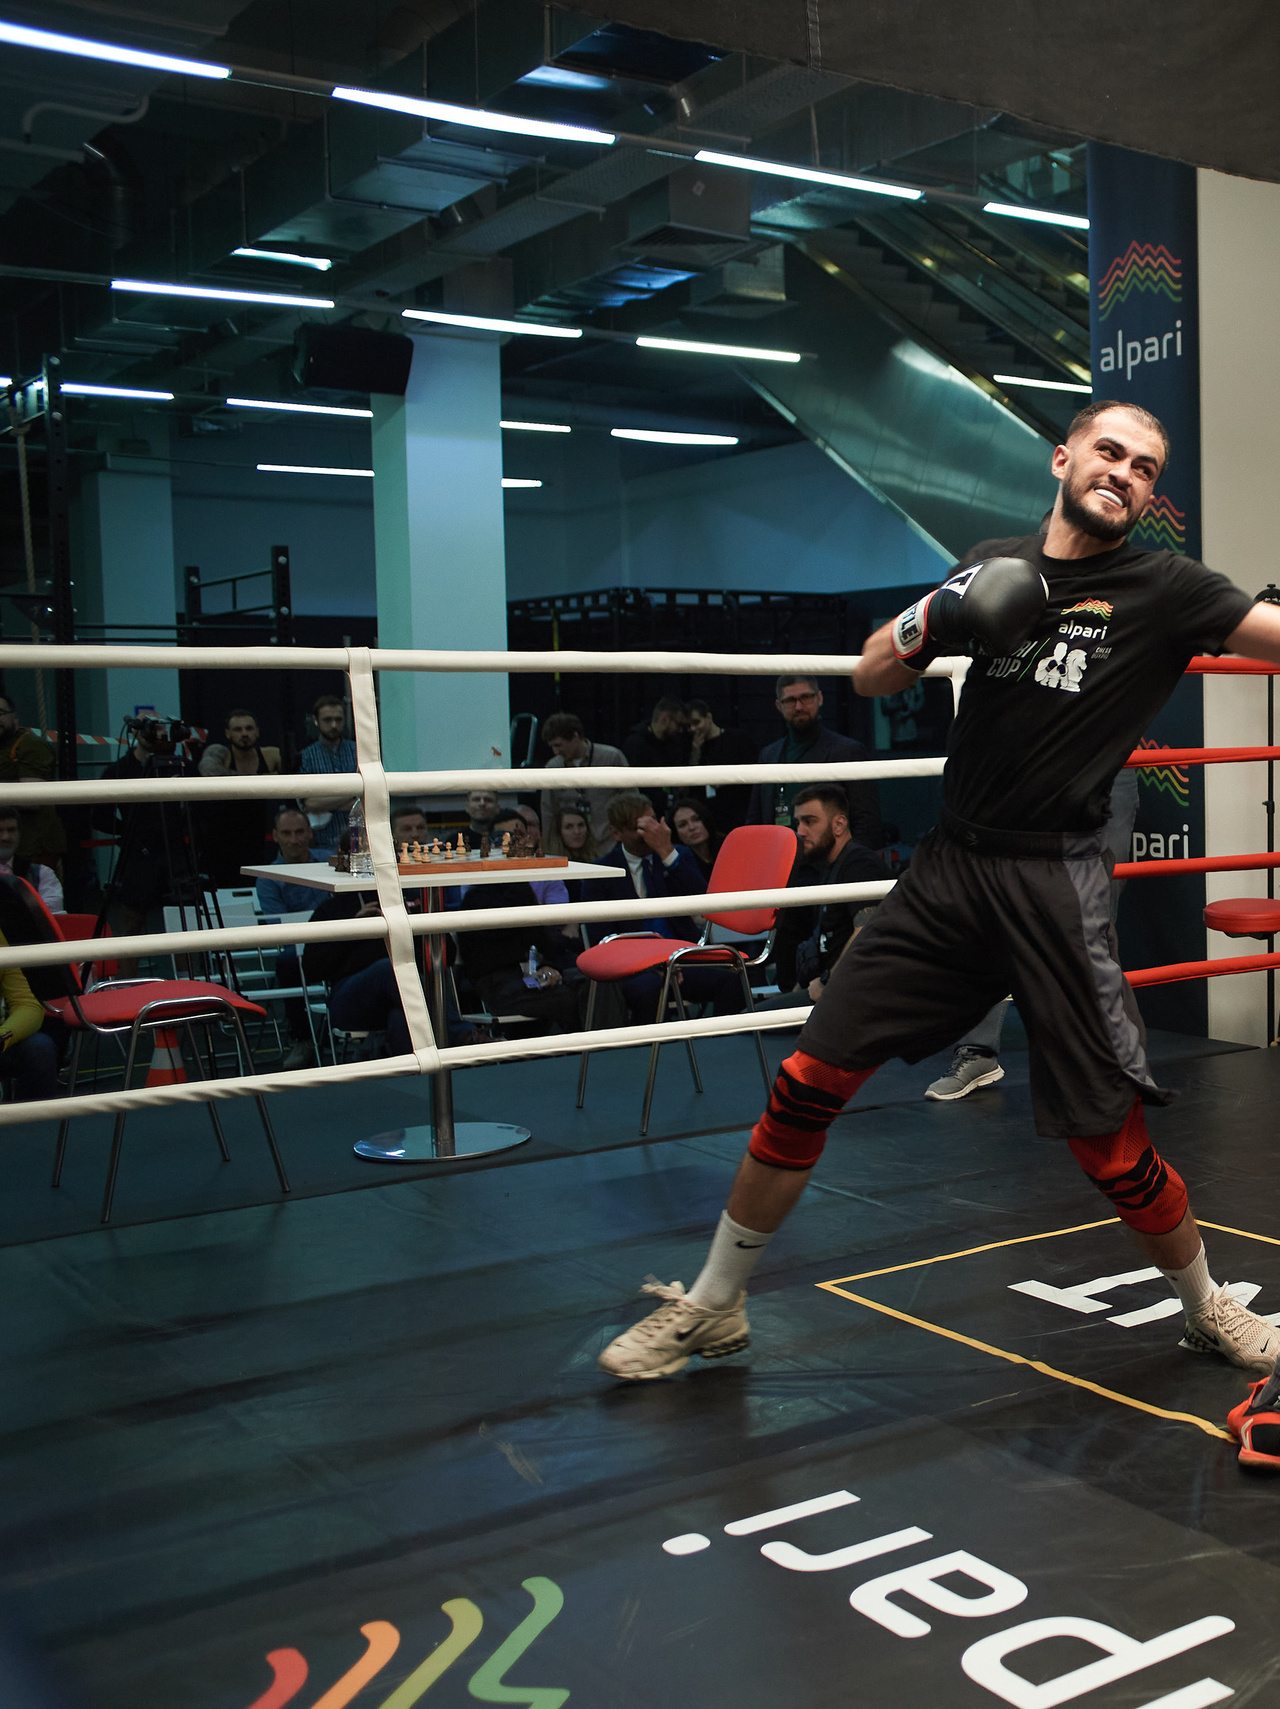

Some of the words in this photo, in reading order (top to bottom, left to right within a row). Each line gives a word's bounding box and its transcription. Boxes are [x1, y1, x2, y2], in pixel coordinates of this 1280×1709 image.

[1100, 319, 1182, 381] alpari
[1058, 620, 1108, 640] alpari
[986, 657, 1022, 678] CUP
[1132, 823, 1190, 863] pari
[662, 1489, 1236, 1709] pari
